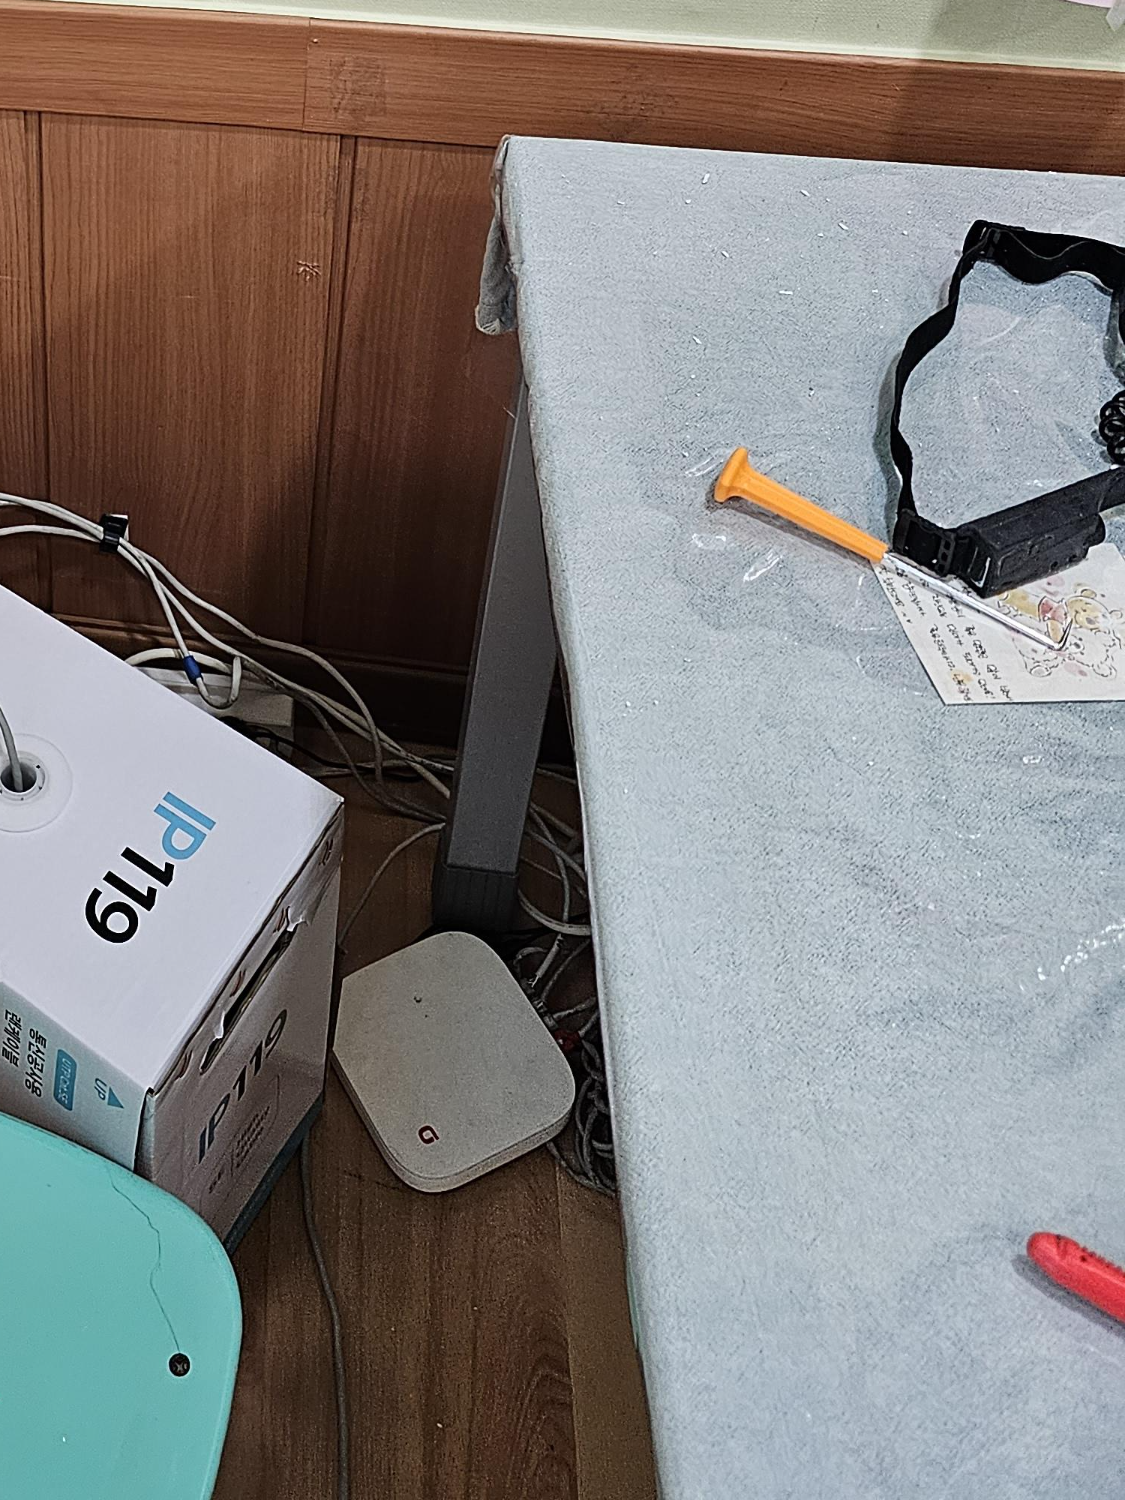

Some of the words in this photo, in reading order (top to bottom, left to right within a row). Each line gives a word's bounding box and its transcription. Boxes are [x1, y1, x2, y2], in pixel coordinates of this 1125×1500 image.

[85, 791, 216, 944] IP119
[1, 1008, 22, 1068] 랜케이블
[24, 1028, 48, 1099] 통신공사용
[94, 1077, 107, 1102] UP
[198, 1009, 287, 1164] IP119
